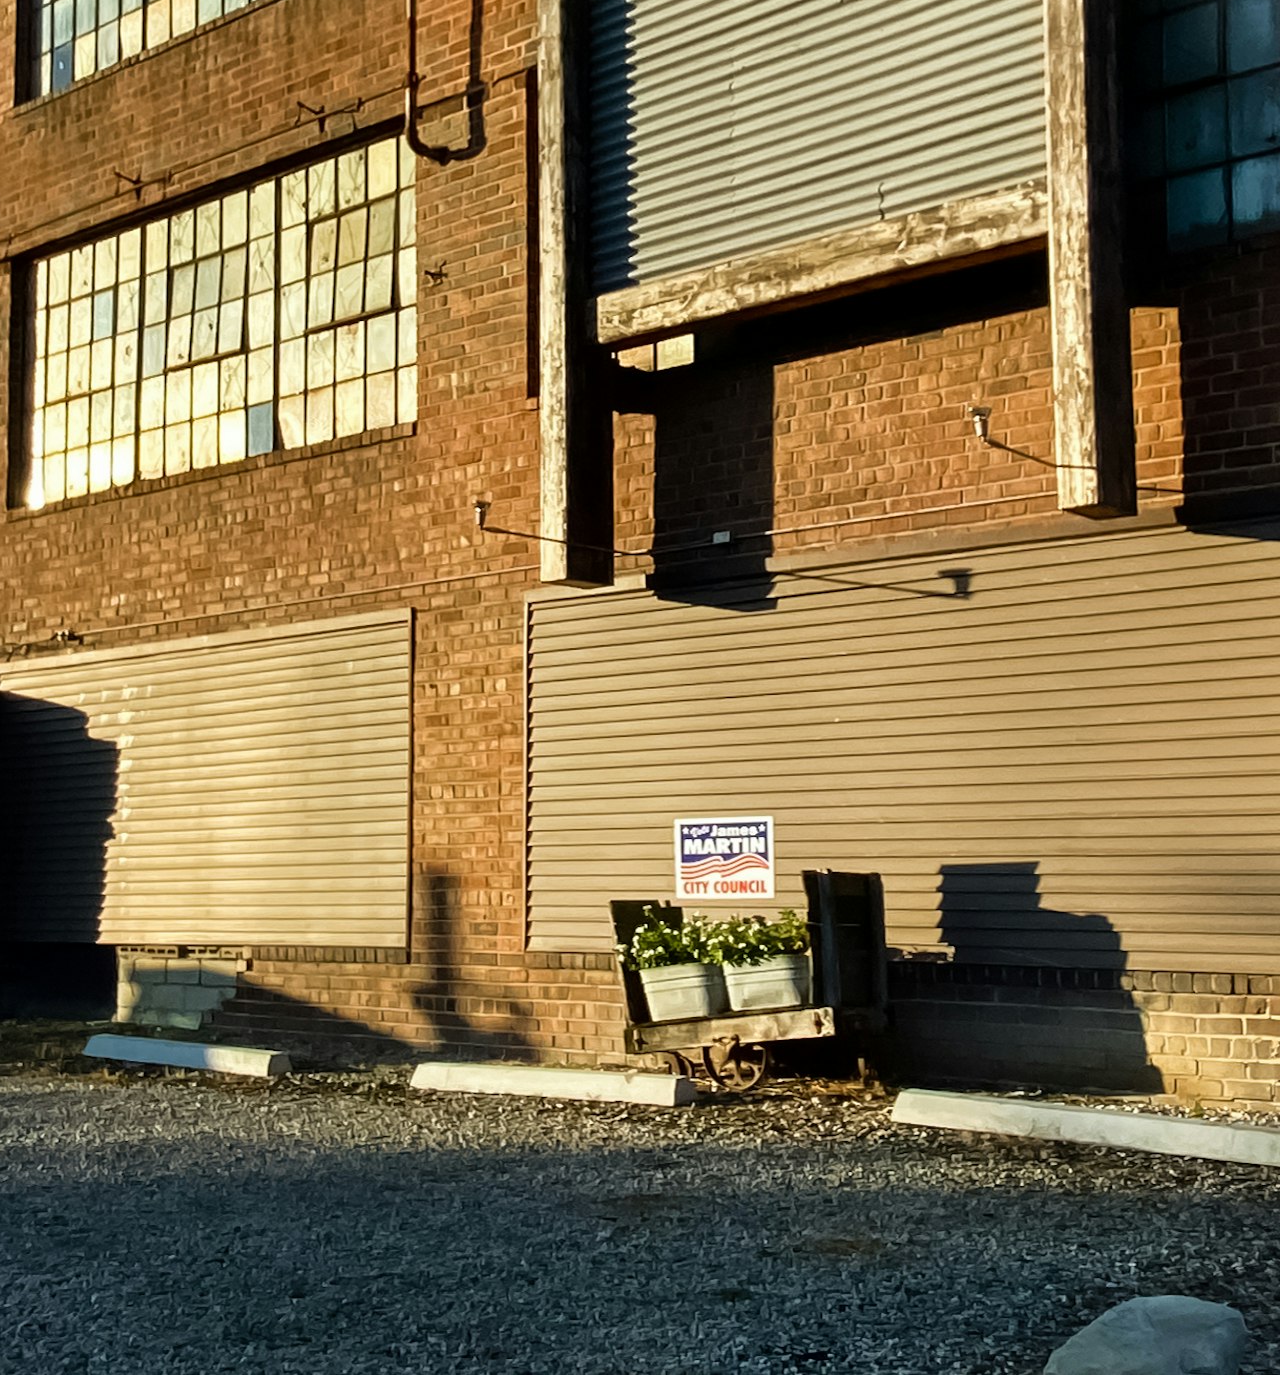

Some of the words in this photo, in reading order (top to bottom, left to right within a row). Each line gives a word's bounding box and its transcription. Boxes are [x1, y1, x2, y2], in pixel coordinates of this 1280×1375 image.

[710, 825, 758, 837] James
[684, 837, 765, 854] MARTIN
[683, 881, 709, 894] CITY
[713, 880, 767, 894] COUNCIL
